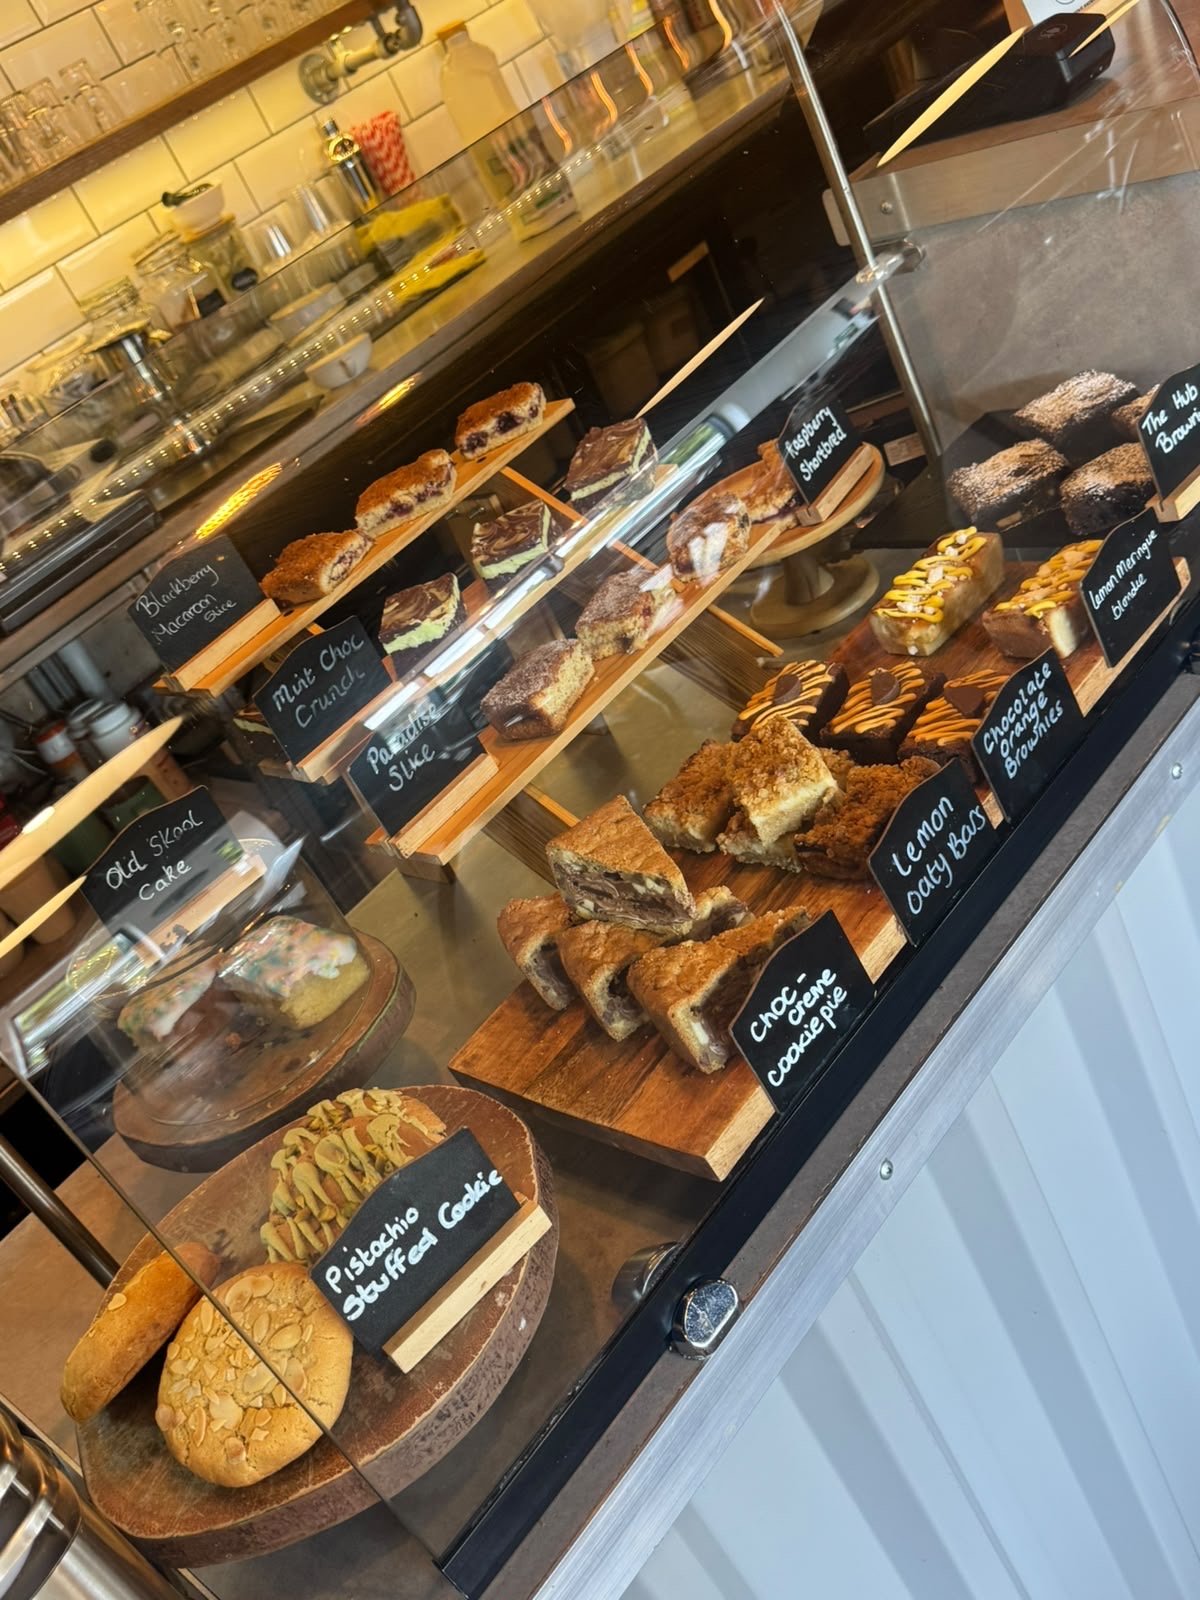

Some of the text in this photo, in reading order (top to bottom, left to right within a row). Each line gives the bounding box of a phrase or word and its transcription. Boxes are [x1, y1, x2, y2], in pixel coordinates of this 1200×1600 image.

[784, 406, 838, 459] Raspberry
[1141, 383, 1198, 436] The Hub
[1115, 529, 1159, 579] Meringue
[135, 564, 219, 618] Blackberry
[151, 593, 218, 645] Macaroon
[271, 633, 365, 712] Mint Choc
[295, 665, 367, 728] Crunch
[983, 662, 1052, 754] Chocolate
[1000, 691, 1049, 759] Orange
[366, 702, 442, 775] Paradise
[388, 743, 435, 792] Slice
[1004, 700, 1064, 779] Brownies
[891, 796, 954, 877] Lemon
[946, 805, 987, 861] Bars
[105, 850, 148, 890] Old
[138, 859, 192, 901] Cake
[325, 1207, 419, 1294] Pistachio
[342, 1169, 503, 1321] Stuffed Cookie
